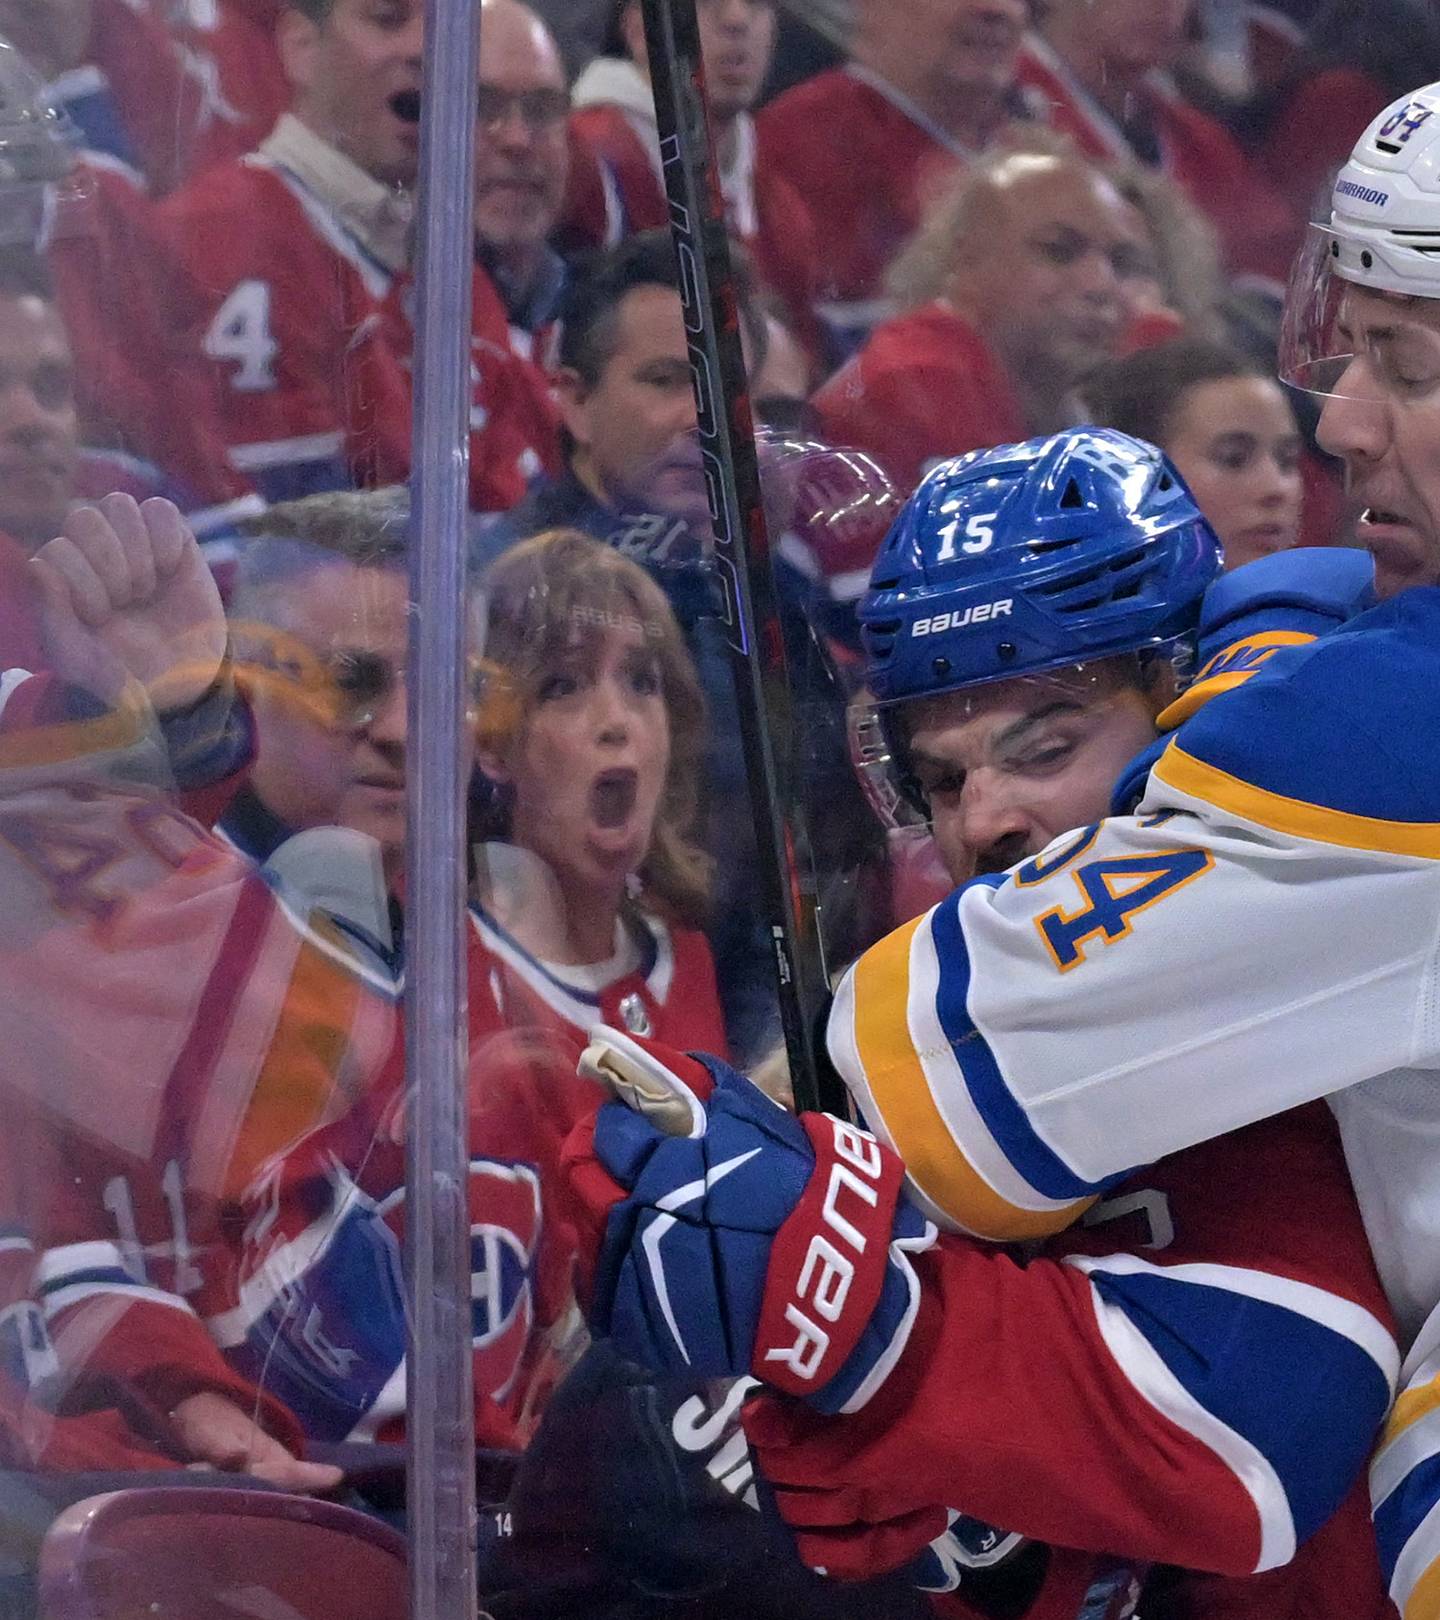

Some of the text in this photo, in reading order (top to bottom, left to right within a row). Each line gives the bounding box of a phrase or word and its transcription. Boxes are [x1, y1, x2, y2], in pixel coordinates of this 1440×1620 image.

[205, 279, 277, 390] 4
[937, 513, 998, 561] 15
[912, 599, 1013, 637] BAUER
[764, 1111, 881, 1380] AUER
[495, 1512, 513, 1537] 14
